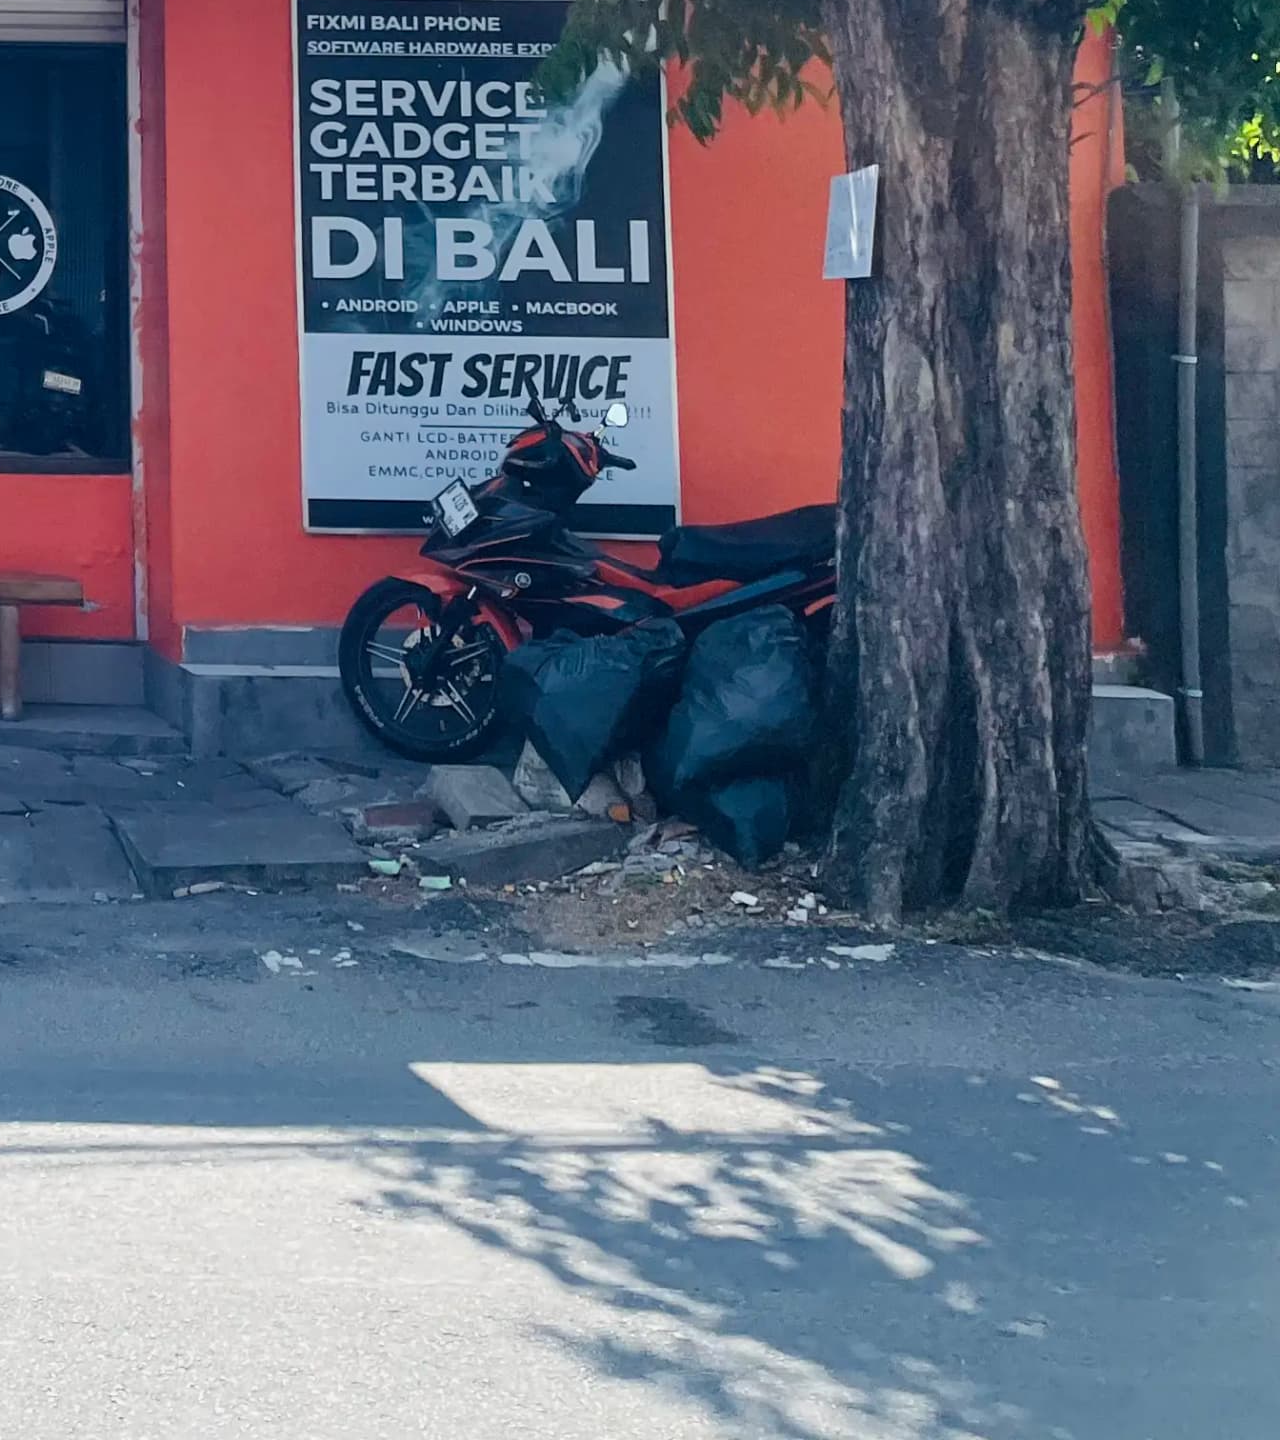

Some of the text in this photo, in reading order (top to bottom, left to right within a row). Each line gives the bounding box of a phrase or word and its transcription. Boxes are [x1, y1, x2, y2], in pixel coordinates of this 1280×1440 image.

[306, 14, 501, 32] FIXMI BALI PHONE
[307, 41, 405, 55] SOFTWARE
[409, 42, 513, 56] HARDWARE
[309, 79, 548, 117] SERVICE
[309, 121, 543, 160] GADGET
[44, 227, 55, 264] APPLE
[311, 215, 650, 283] DI BALI
[335, 298, 618, 316] ANDROID APPLE MACBOOK
[431, 319, 523, 333] WINDOWS
[346, 351, 632, 400] FAST SERVICE
[326, 401, 359, 414] Bisa
[365, 402, 439, 418] Ditunggu
[446, 403, 476, 416] Dan
[483, 404, 530, 417] Diliha
[360, 431, 410, 442] GANTI
[425, 449, 499, 461] ANDROID
